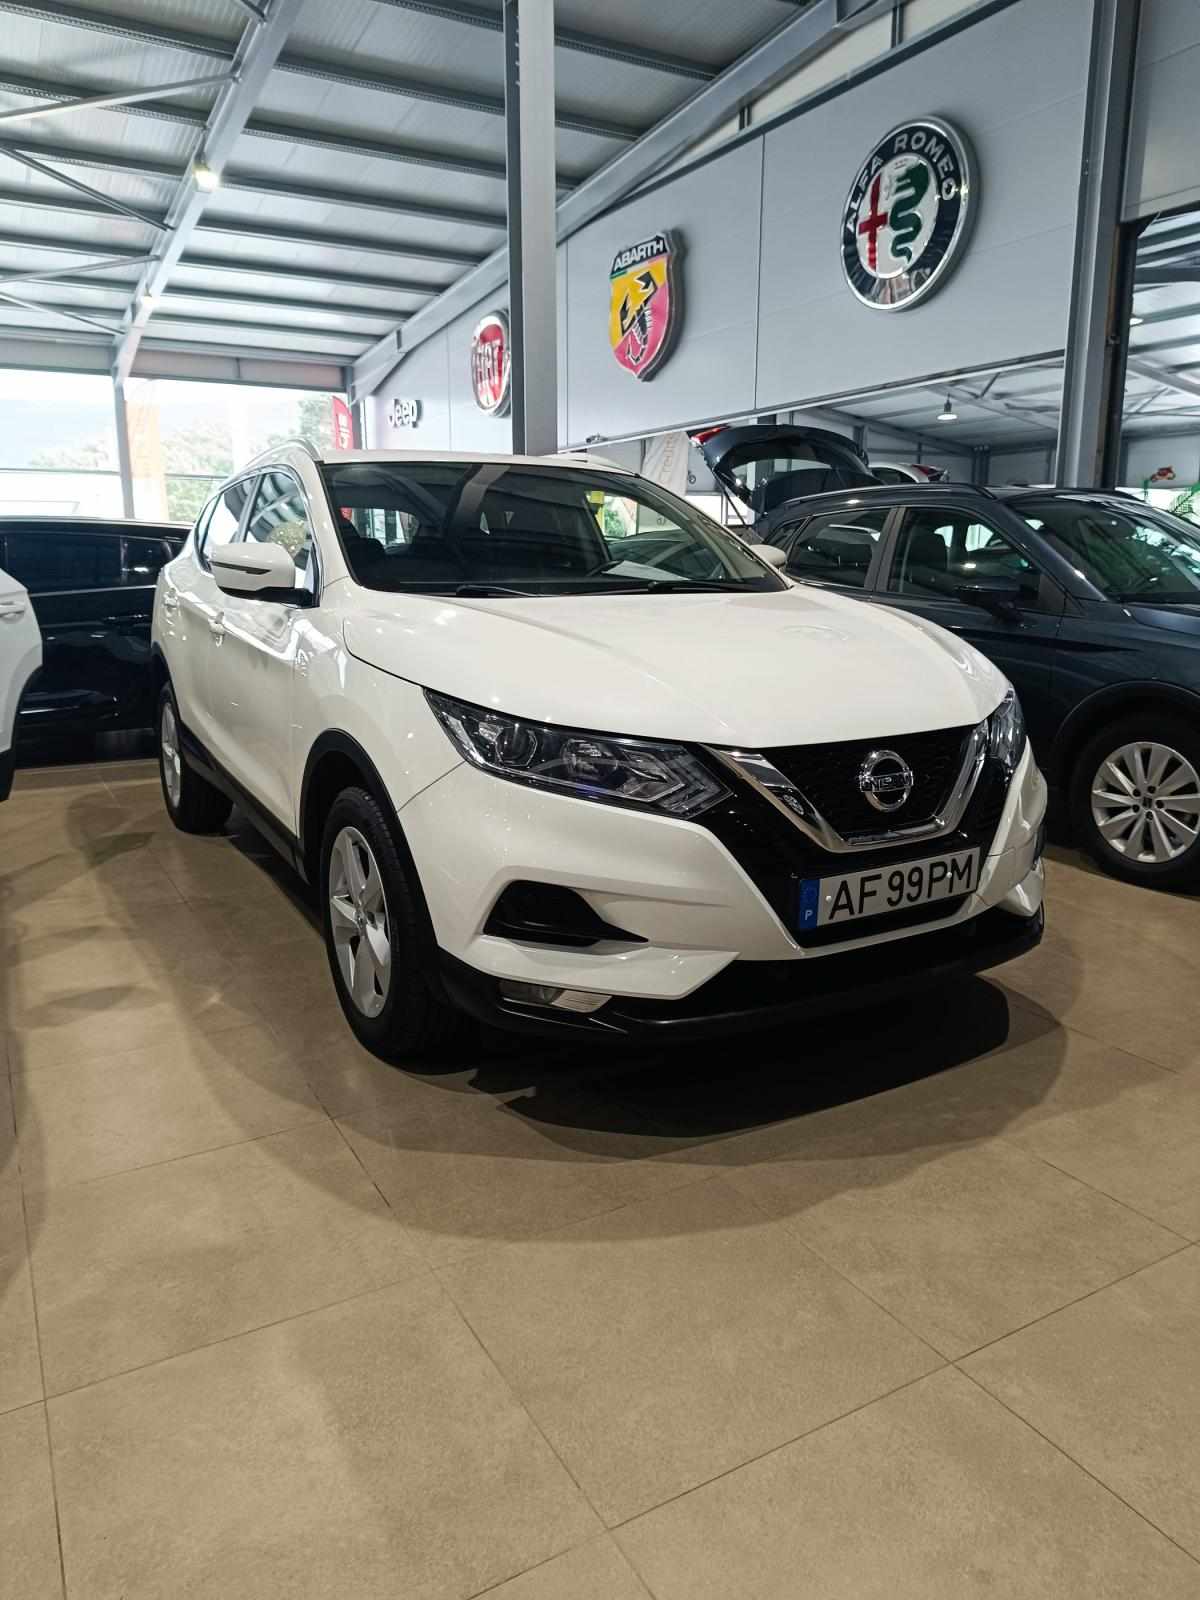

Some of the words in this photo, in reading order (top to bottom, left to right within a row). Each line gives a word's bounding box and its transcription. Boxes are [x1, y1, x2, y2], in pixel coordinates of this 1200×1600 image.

[846, 156, 884, 232] ALFA
[893, 131, 957, 201] ROMEO
[614, 240, 664, 270] ABARTH
[388, 398, 418, 427] Jeep
